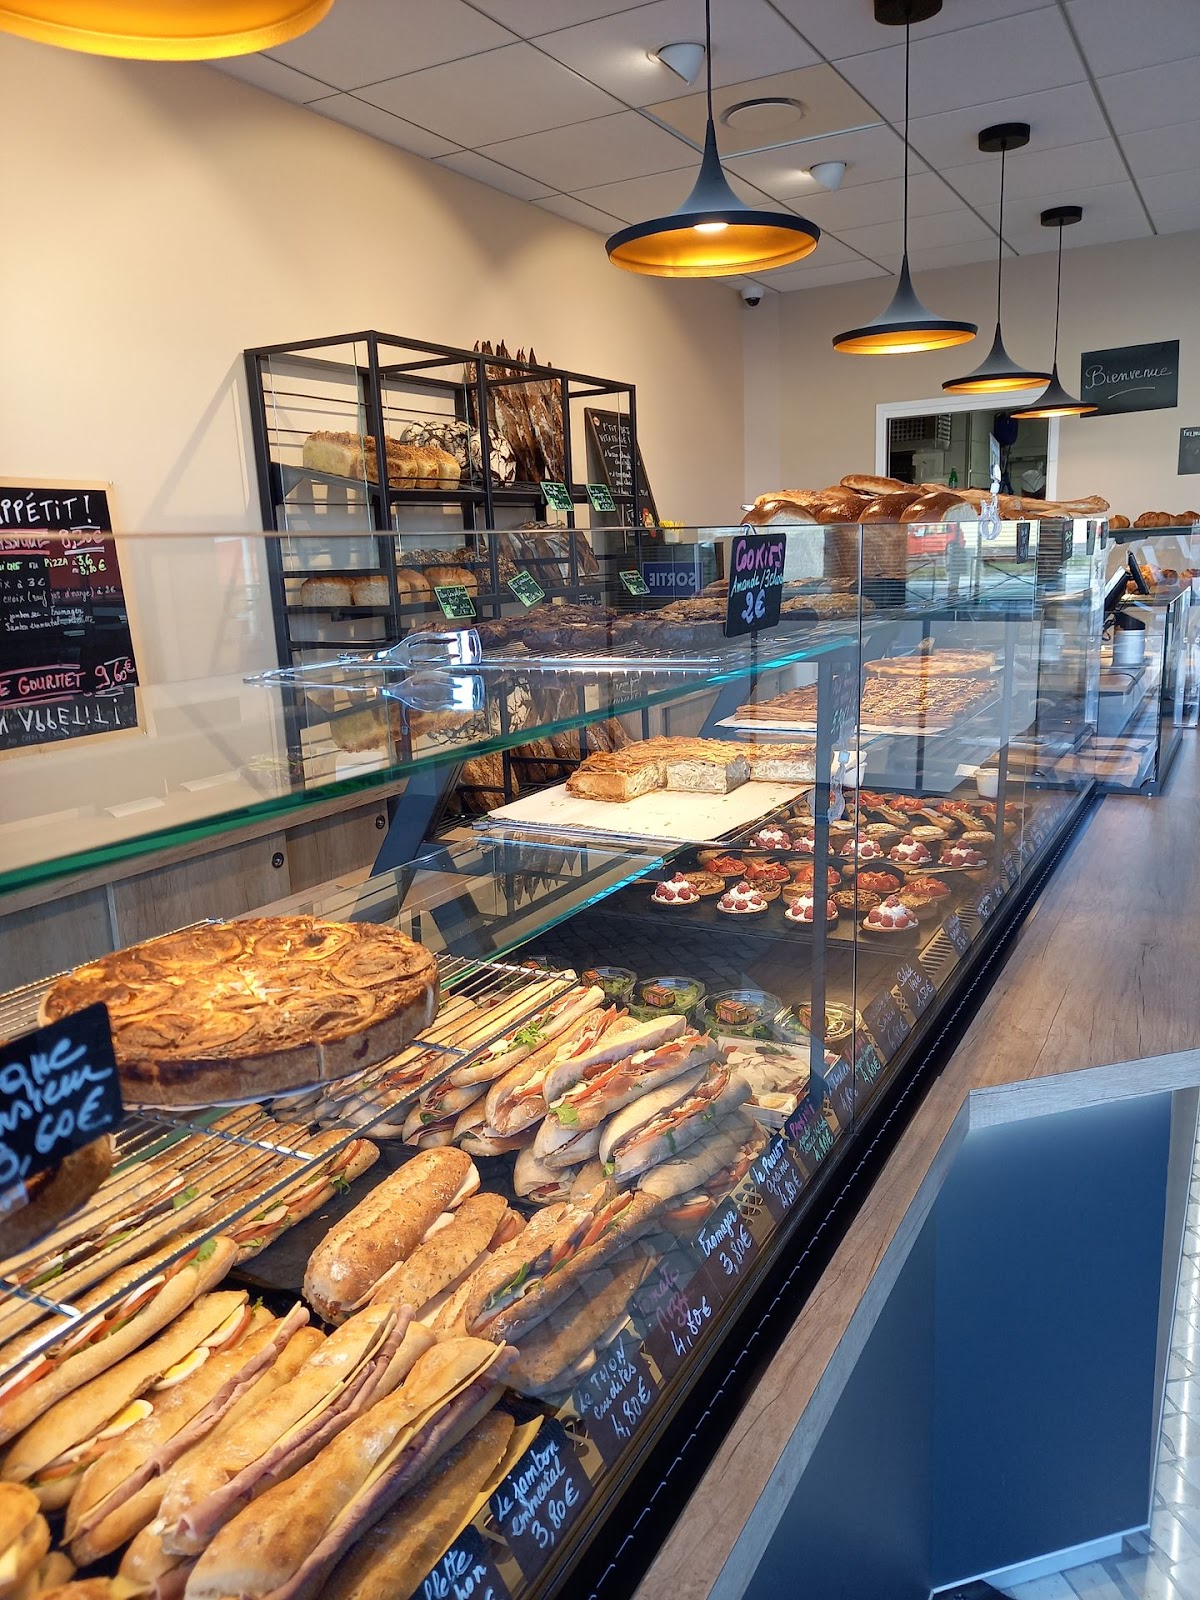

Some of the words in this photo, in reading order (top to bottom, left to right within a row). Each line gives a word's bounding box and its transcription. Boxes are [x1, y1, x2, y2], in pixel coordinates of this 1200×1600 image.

[1085, 365, 1172, 389] Bienvenue
[0, 492, 78, 523] PPÉTiT
[18, 671, 86, 695] GOURMET
[718, 1224, 753, 1276] 3,80€
[670, 1295, 713, 1357] 4,80€
[611, 1375, 651, 1441] 4,80€
[506, 1440, 560, 1507] jambon
[531, 1477, 579, 1549] 3,80€
